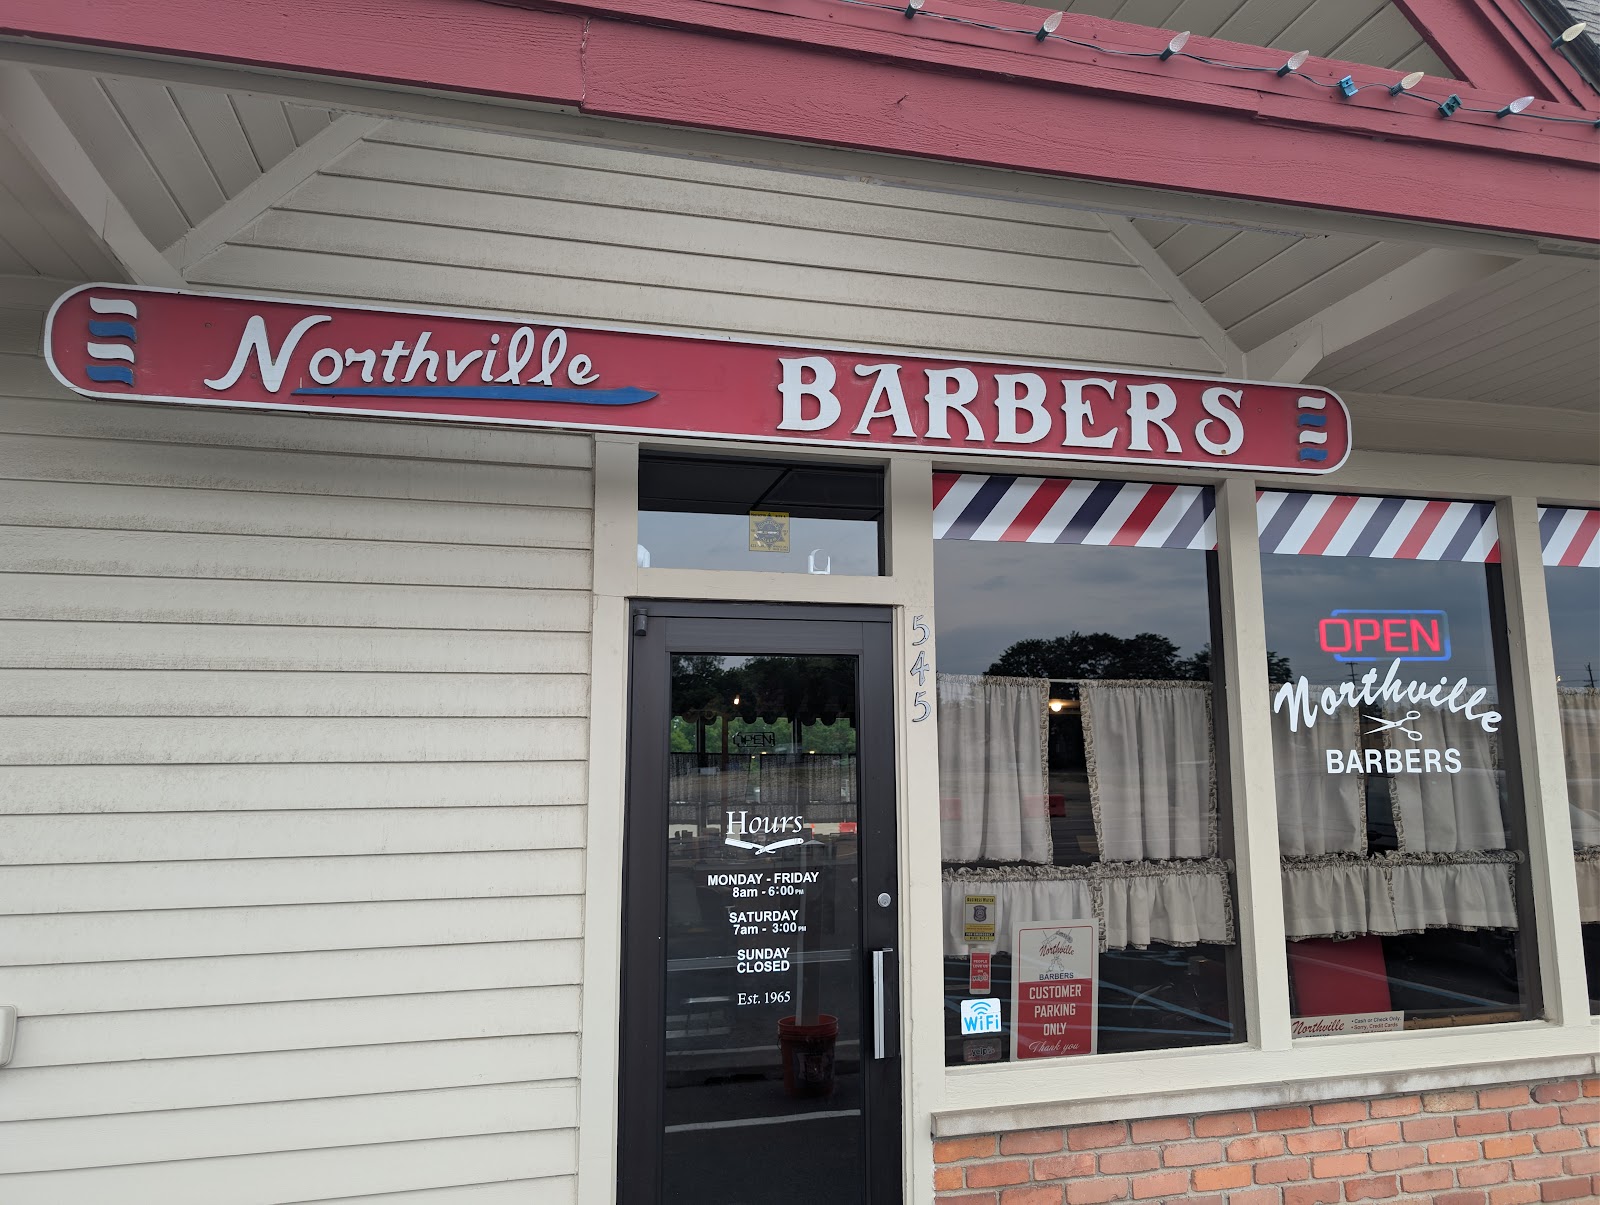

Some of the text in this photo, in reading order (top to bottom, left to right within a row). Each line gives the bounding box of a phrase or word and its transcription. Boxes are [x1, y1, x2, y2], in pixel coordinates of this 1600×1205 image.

[204, 315, 1243, 456] Northville BARBERS
[1319, 618, 1441, 652] OPEN
[1274, 657, 1502, 732] Northville
[1326, 748, 1462, 774] BARBERS
[726, 811, 803, 835] Hours
[707, 873, 764, 886] MONDAY
[774, 871, 819, 884] FRIDAY
[732, 887, 758, 898] 8am
[729, 910, 799, 924] SATURDAY
[733, 924, 759, 935] 7am
[737, 947, 790, 960] SUNDAY
[1039, 941, 1075, 957] Northville
[737, 960, 790, 974] CLOSED
[1039, 972, 1074, 981] BARBERS
[737, 991, 791, 1006] Est. 1965
[1029, 984, 1082, 1000] CUSTOMER
[1034, 1003, 1076, 1018] PARKING
[964, 1014, 999, 1032] WiFi
[1043, 1022, 1067, 1036] ONLY
[1292, 1019, 1345, 1034] Northville
[1029, 1040, 1080, 1055] Thank you
